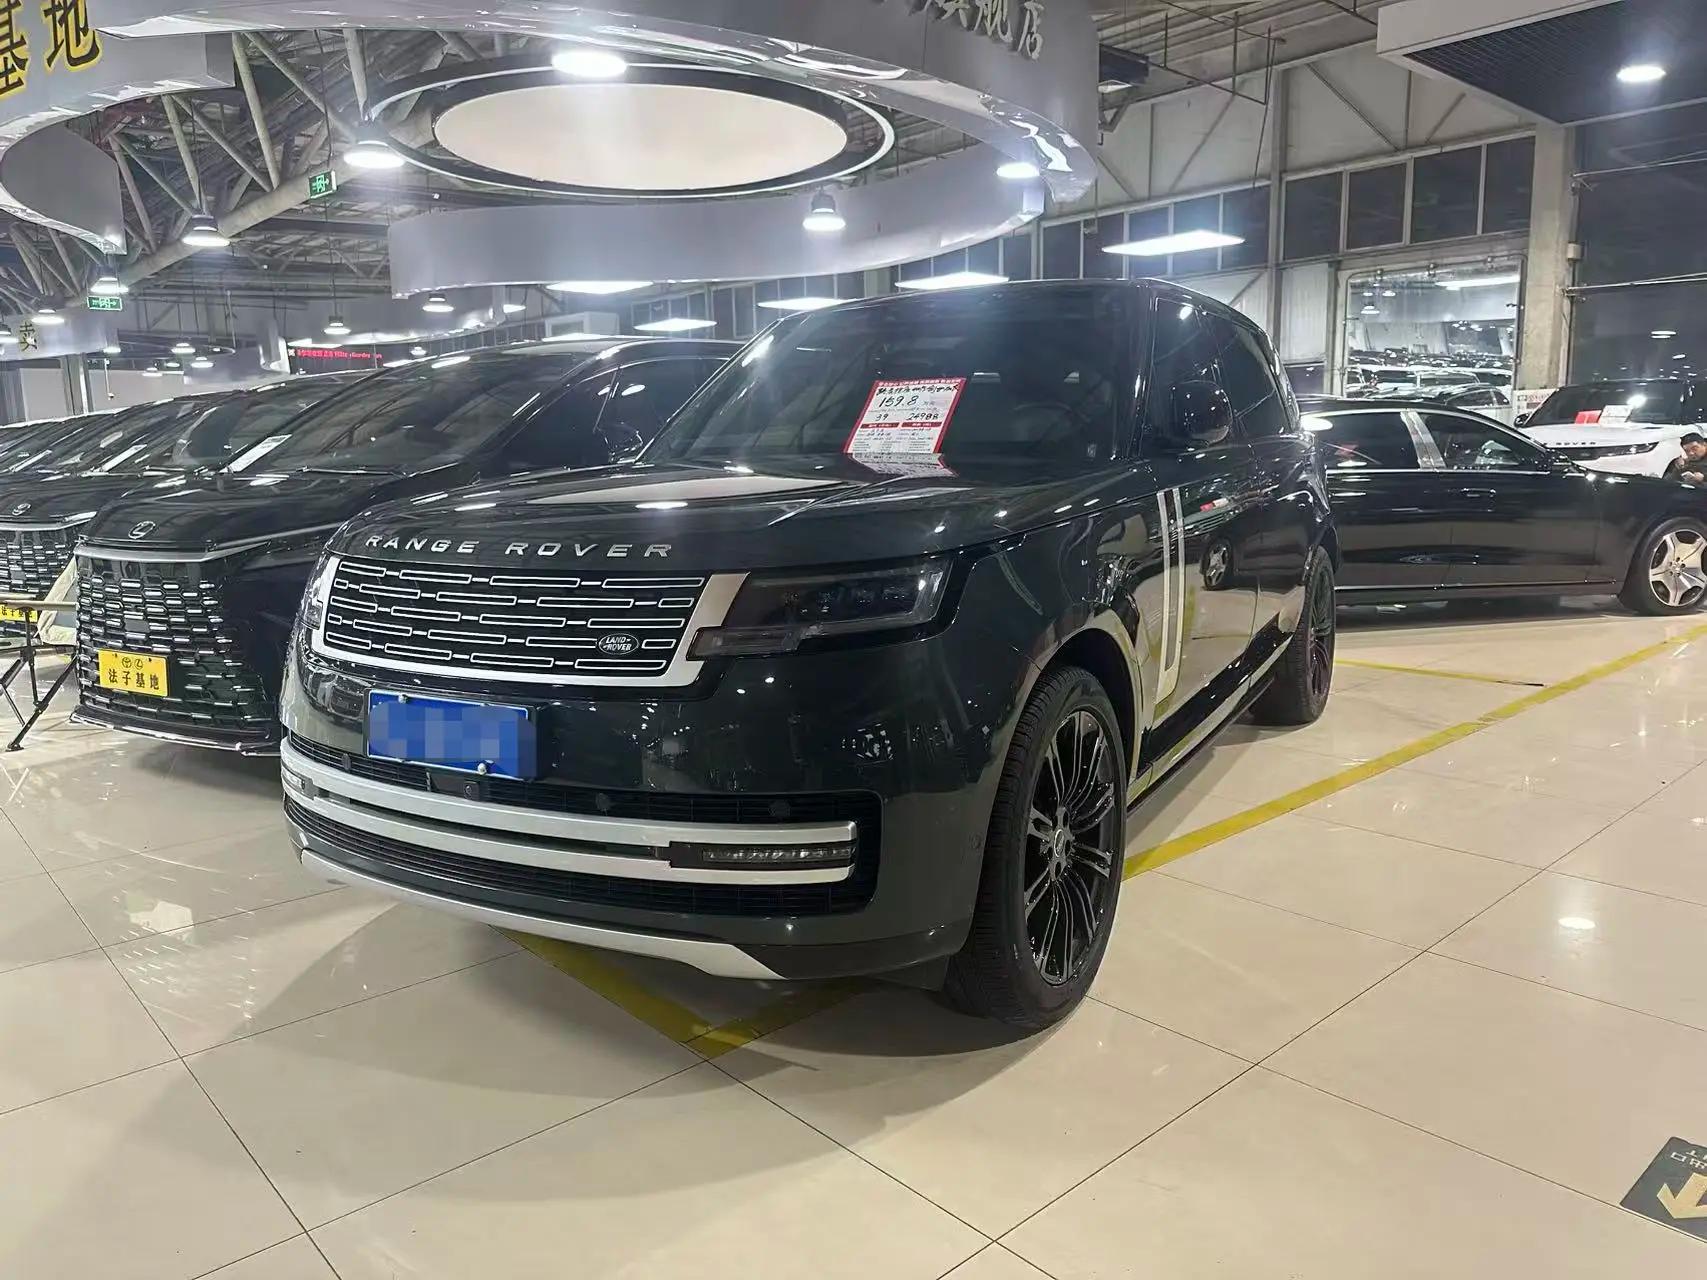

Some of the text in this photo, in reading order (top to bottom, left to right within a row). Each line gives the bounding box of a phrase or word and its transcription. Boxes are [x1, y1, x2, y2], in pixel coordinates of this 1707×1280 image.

[878, 395, 920, 408] 159.8
[366, 535, 672, 557] RANGE ROVER
[605, 636, 627, 644] LAND
[108, 668, 160, 690] 法子基地
